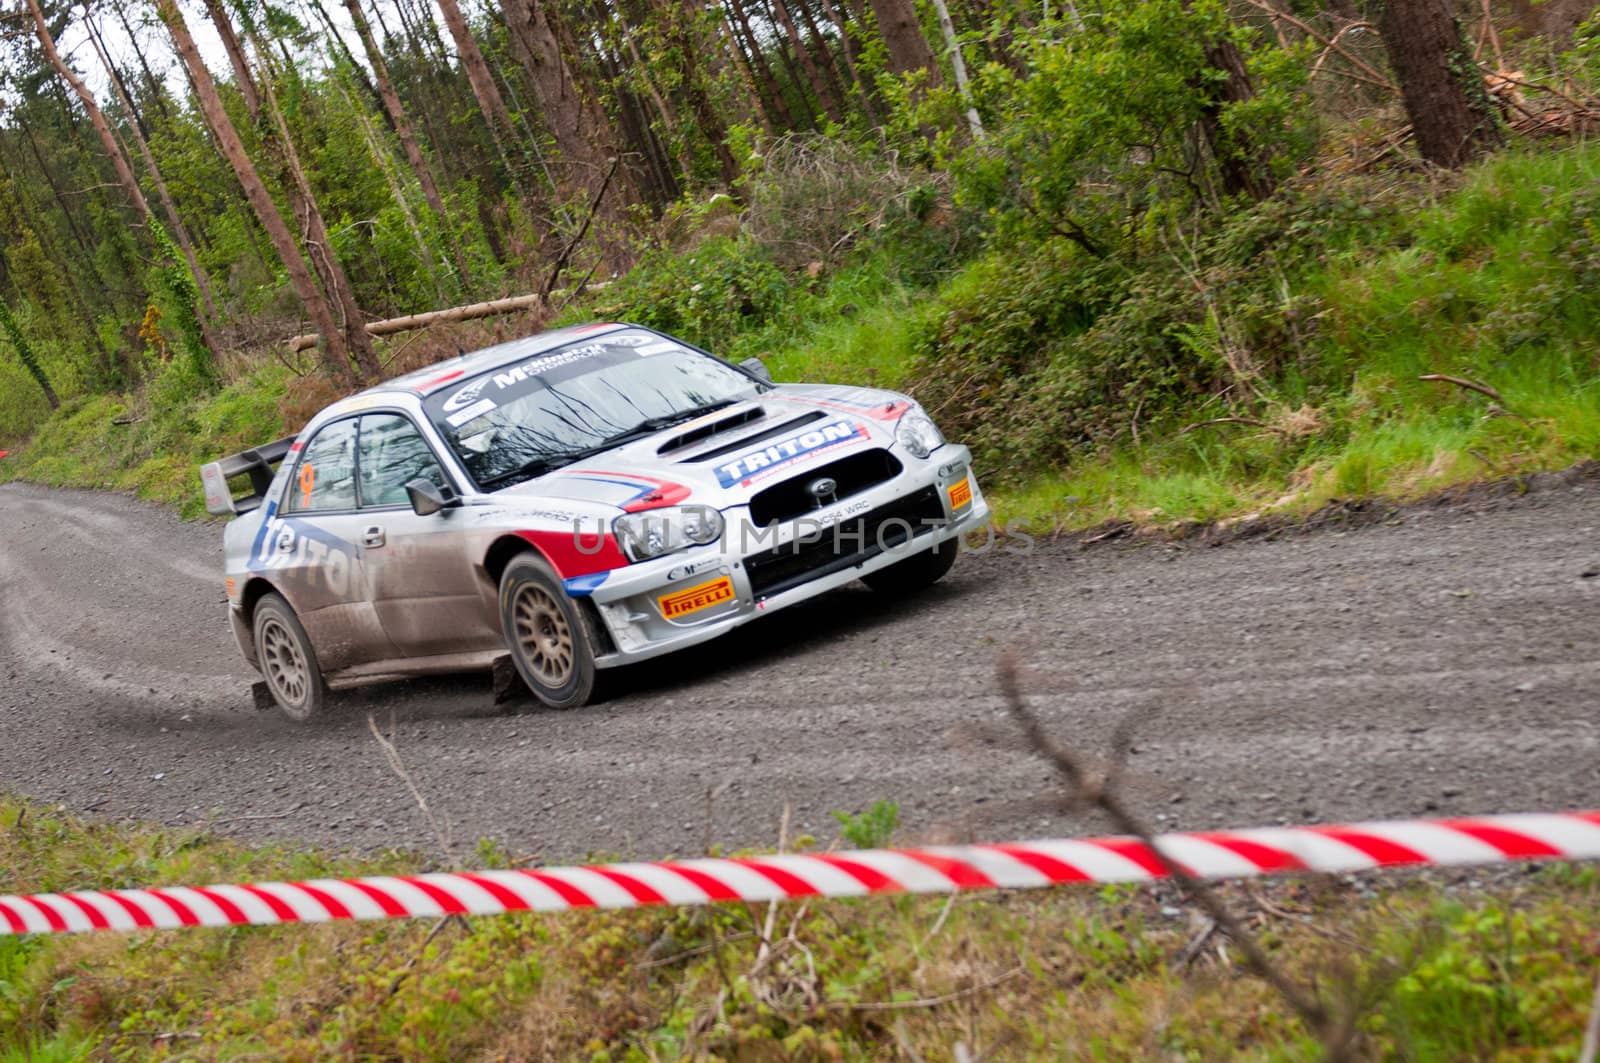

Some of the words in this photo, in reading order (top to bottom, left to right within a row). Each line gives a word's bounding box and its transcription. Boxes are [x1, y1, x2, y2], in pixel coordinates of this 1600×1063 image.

[721, 423, 853, 480] TRITON
[300, 463, 314, 508] 9
[844, 500, 870, 513] WRC
[662, 581, 731, 616] PIRELLI
